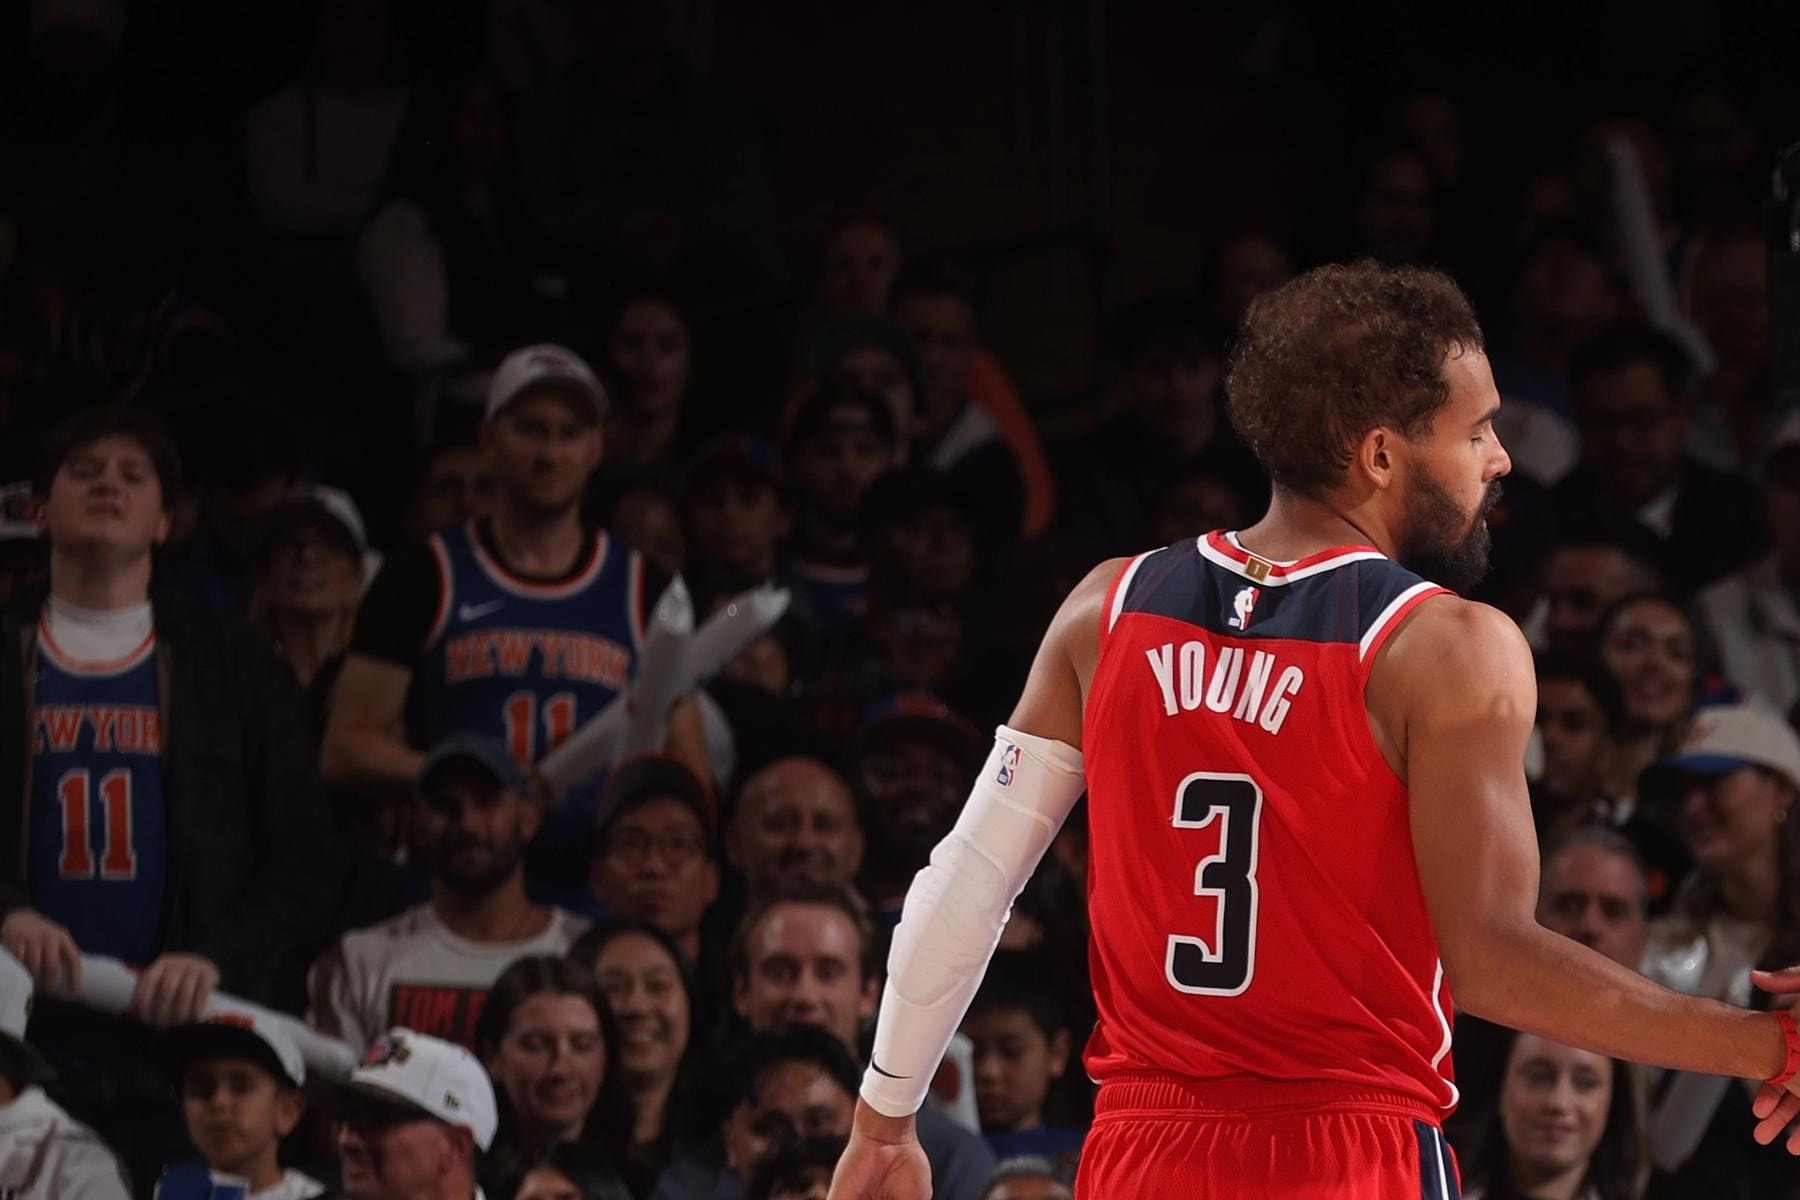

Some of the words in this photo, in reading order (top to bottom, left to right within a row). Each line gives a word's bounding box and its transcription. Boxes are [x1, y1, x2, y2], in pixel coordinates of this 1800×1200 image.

[445, 629, 534, 687] NEW
[1145, 641, 1304, 735] YOUNG
[88, 704, 163, 757] YOR
[57, 767, 137, 881] 11
[1165, 771, 1263, 997] 3
